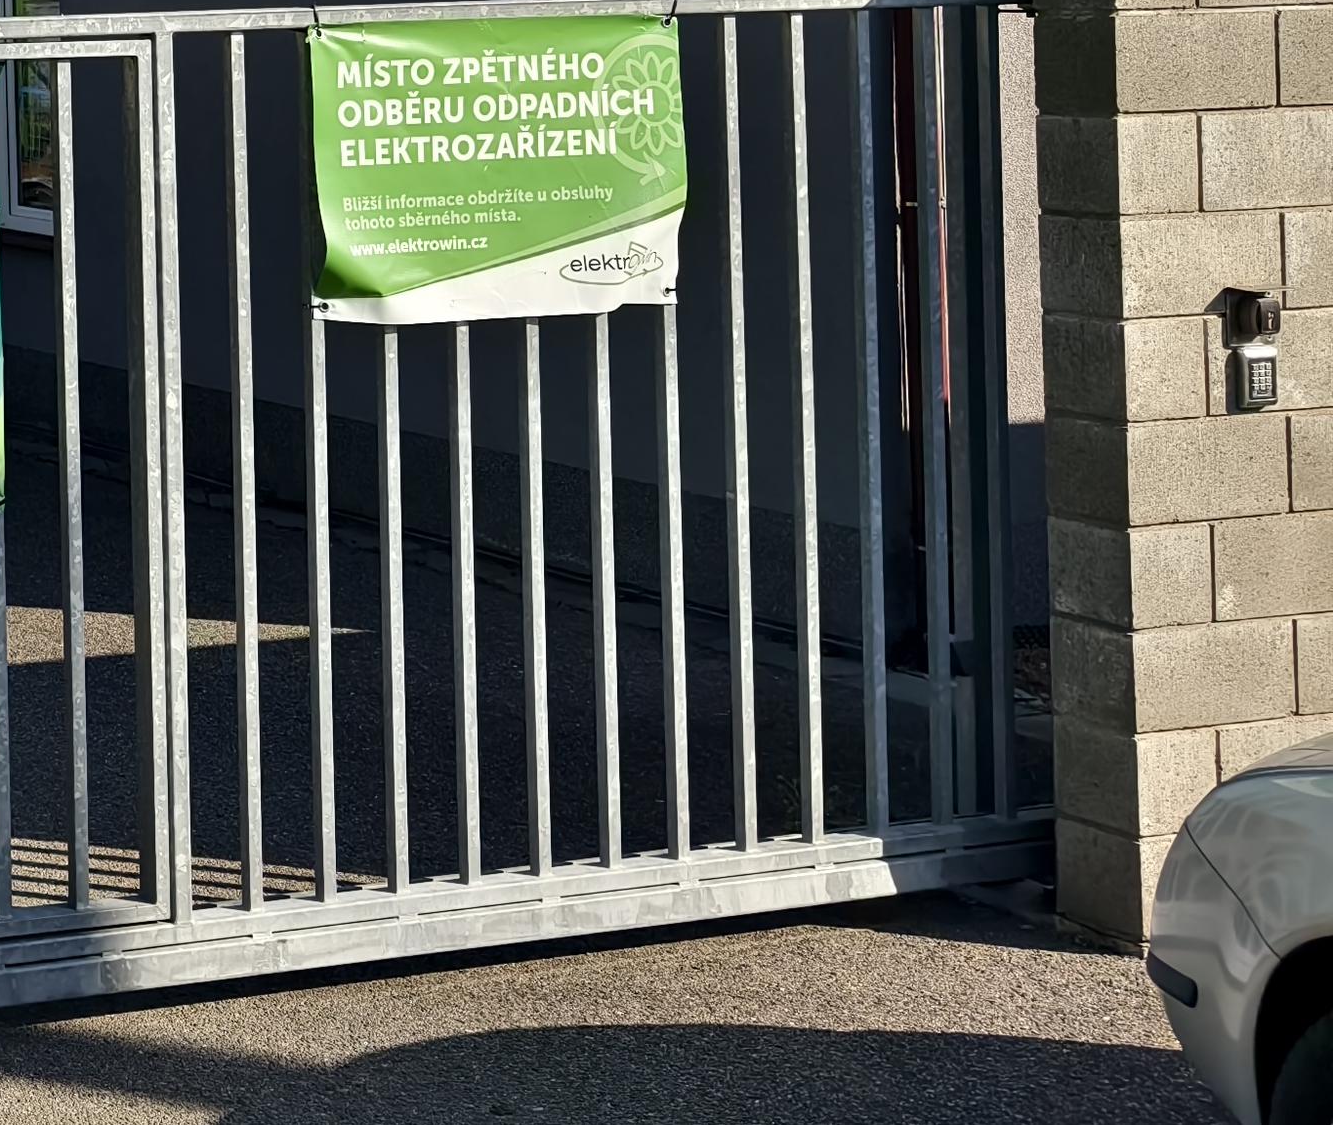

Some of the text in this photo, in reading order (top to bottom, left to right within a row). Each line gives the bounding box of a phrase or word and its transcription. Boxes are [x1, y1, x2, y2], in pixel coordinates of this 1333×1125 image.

[337, 47, 605, 89] MÍSTO ZPĚTNÉHO
[338, 84, 655, 128] ODBĚRU ODPADNÍCH
[340, 122, 618, 167] ELEKTROZAŘÍZENÍ
[342, 186, 614, 212] Bližší informace obdržíte u obsluhy
[345, 207, 521, 230] tohoto sběrného místa.
[350, 235, 488, 257] www.elektrowin.cz
